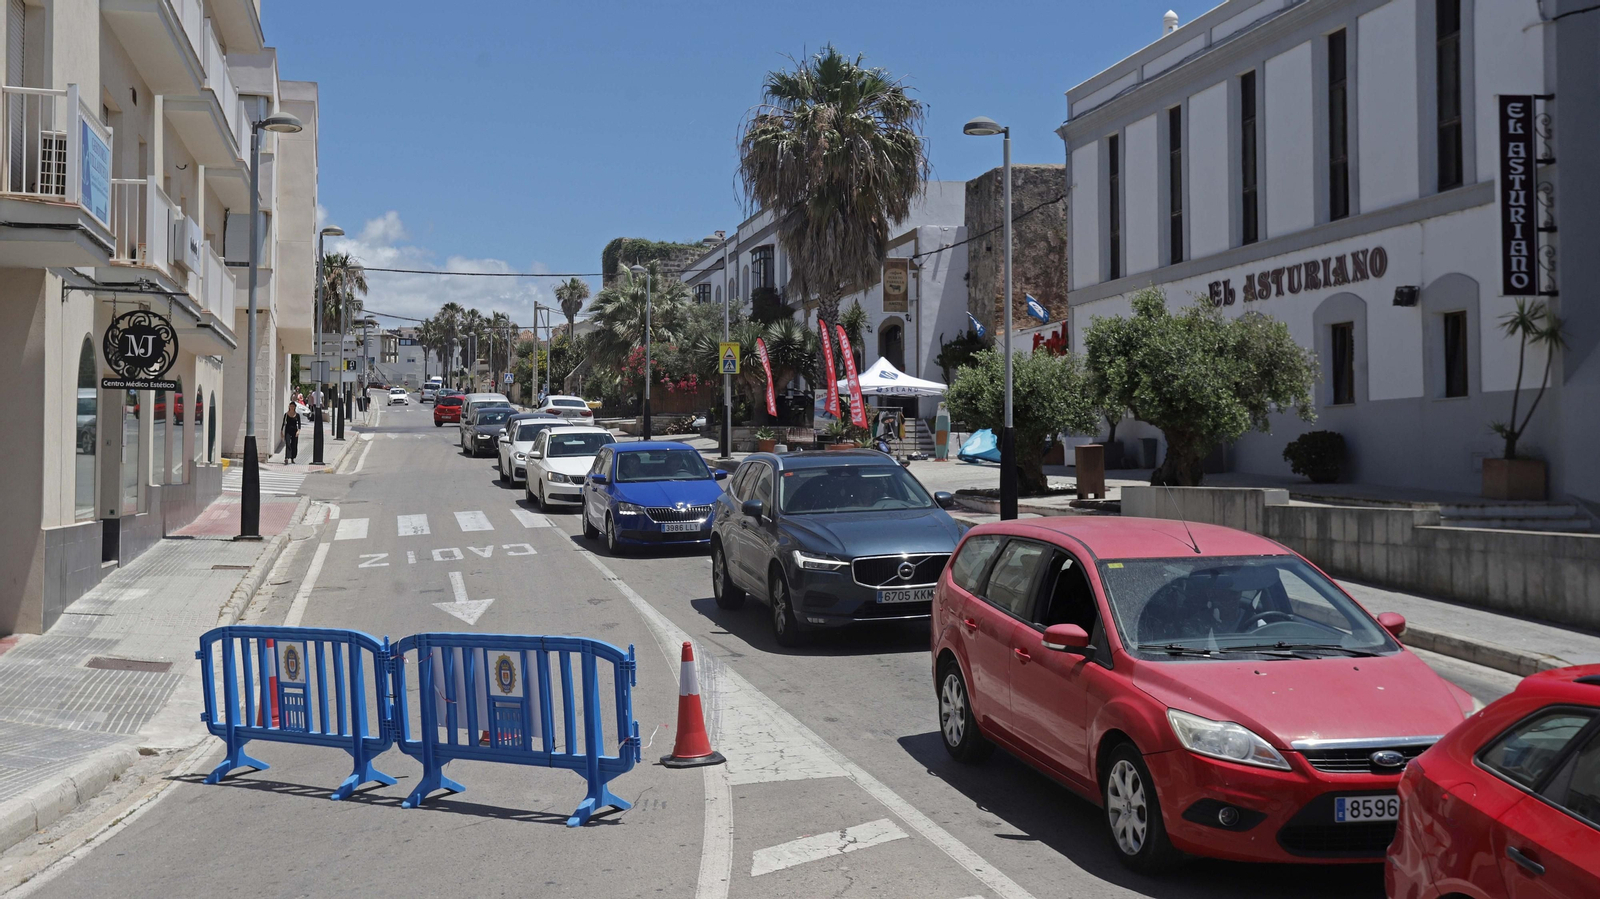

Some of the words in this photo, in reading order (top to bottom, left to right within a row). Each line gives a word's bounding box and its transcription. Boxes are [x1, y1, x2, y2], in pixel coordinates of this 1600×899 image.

[1507, 103, 1525, 134] EL
[1507, 142, 1529, 289] ASTURIANO
[1208, 279, 1236, 308] EL
[1243, 246, 1388, 303] ASTURIANO
[884, 590, 911, 601] 6705
[1350, 799, 1398, 818] 8596
